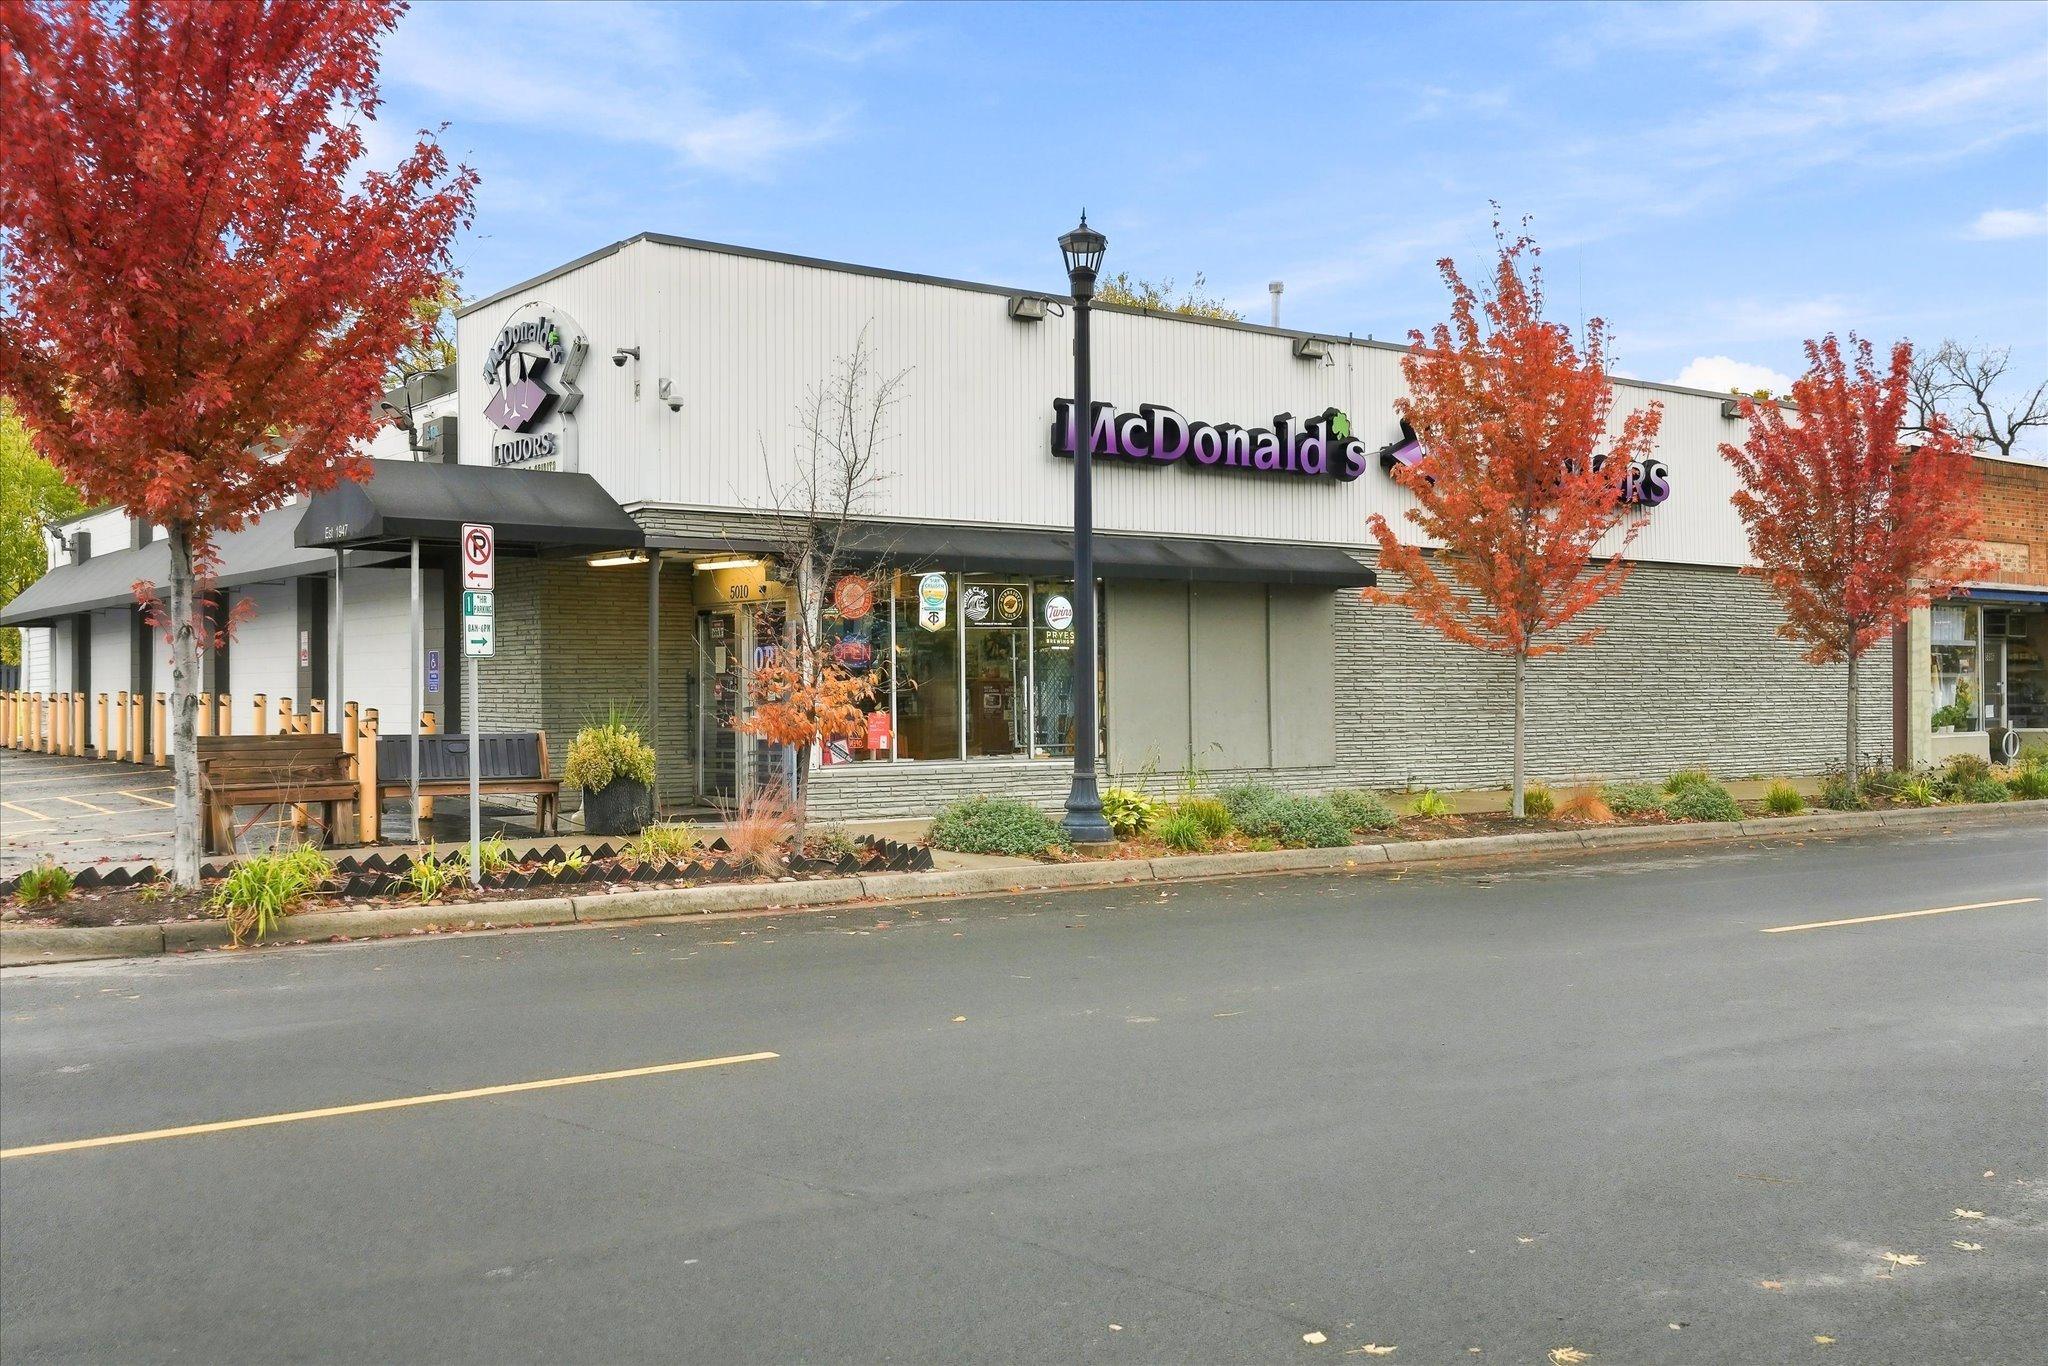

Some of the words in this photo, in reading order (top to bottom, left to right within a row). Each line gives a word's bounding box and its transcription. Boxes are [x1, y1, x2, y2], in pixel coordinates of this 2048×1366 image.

[493, 432, 557, 466] LIQUORS
[729, 585, 749, 599] 5010
[473, 605, 493, 614] PARKING
[1048, 605, 1073, 619] Twins
[1046, 631, 1075, 640] PRYES
